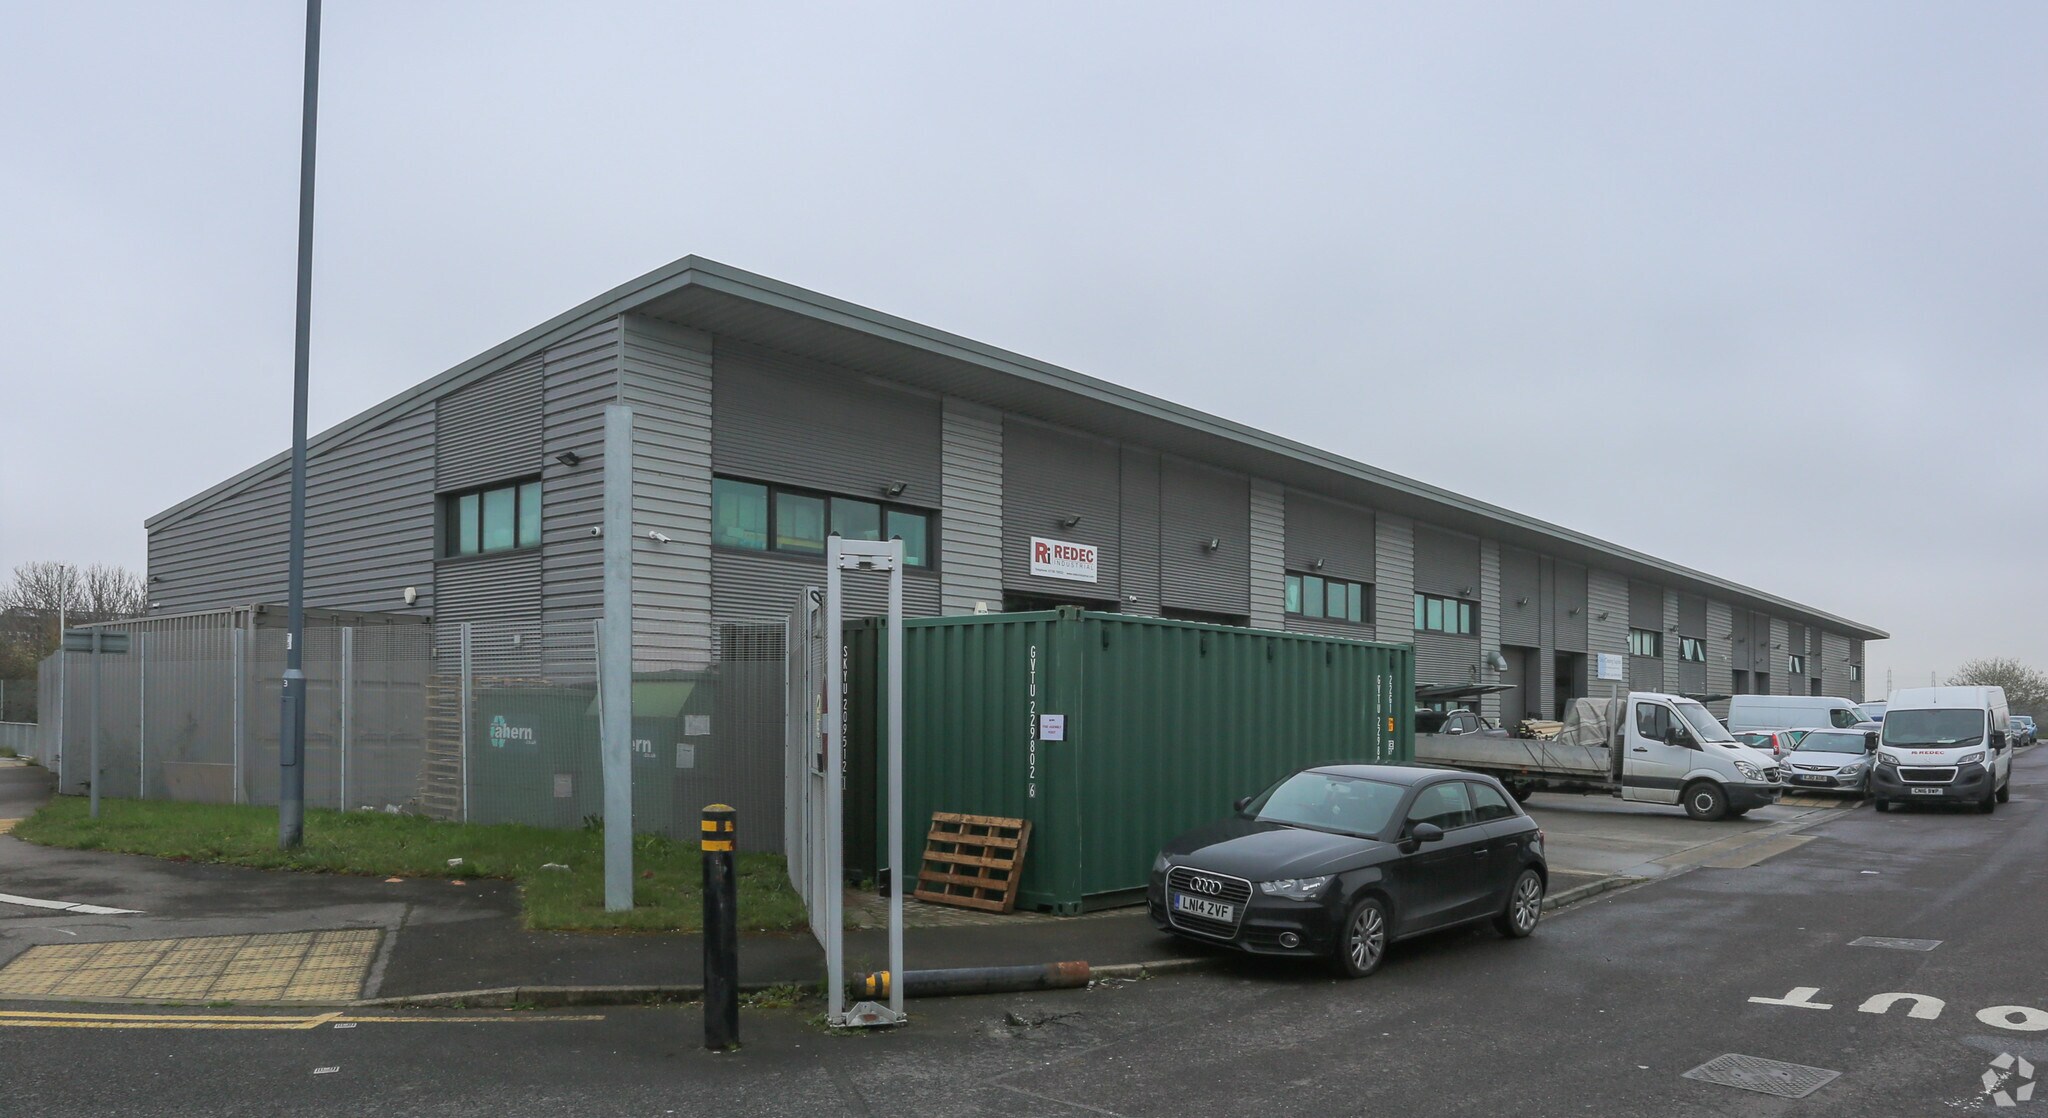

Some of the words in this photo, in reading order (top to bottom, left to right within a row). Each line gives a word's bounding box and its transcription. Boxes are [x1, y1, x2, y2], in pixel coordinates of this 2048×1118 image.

[1054, 545, 1094, 563] REDEC
[1053, 560, 1094, 571] INDUSTRIAL
[495, 723, 533, 740] ahern
[1029, 784, 1035, 797] 6
[1182, 896, 1205, 913] LN14
[1207, 902, 1229, 918] ZVF
